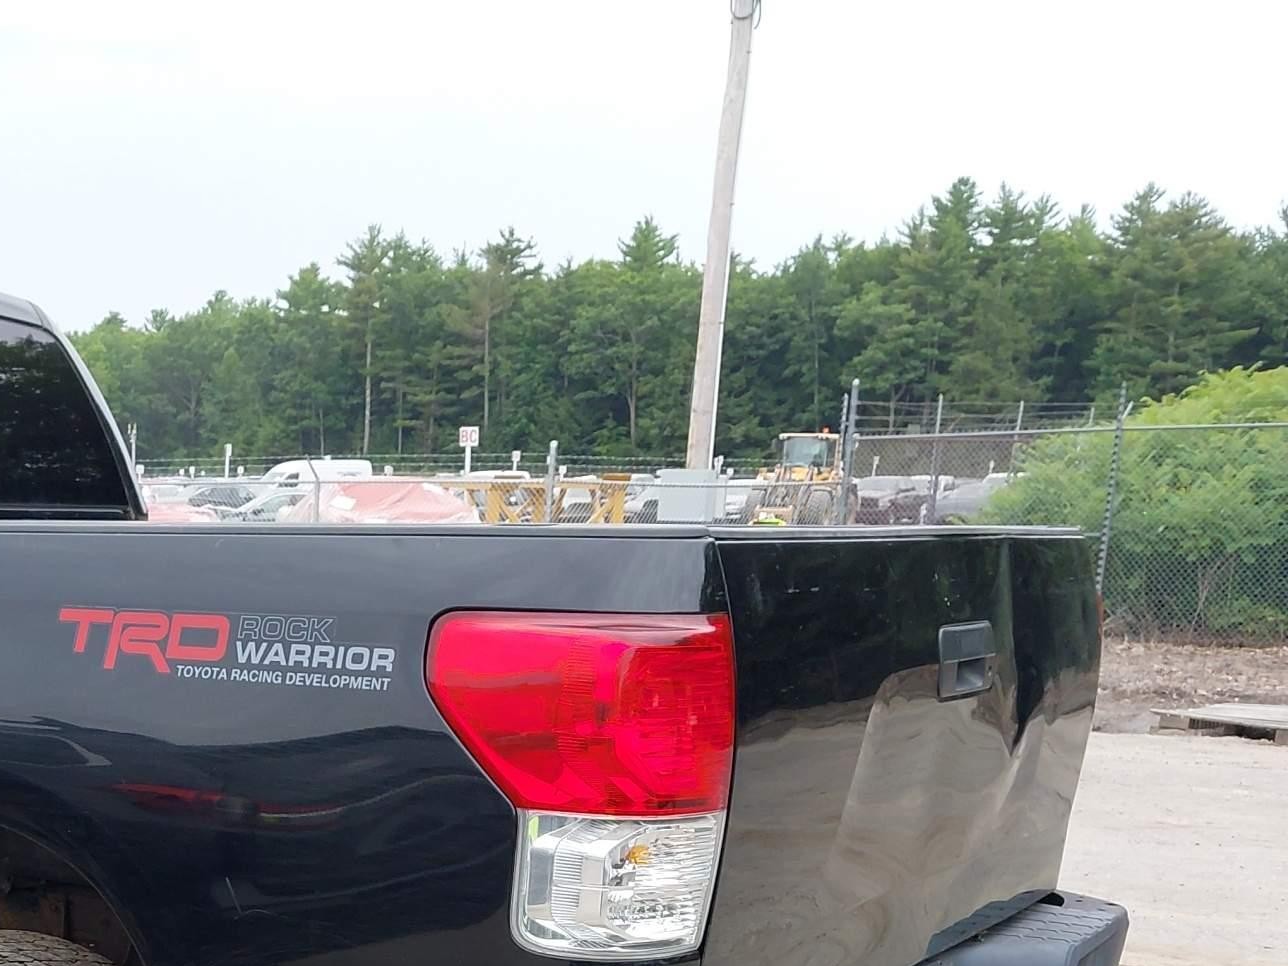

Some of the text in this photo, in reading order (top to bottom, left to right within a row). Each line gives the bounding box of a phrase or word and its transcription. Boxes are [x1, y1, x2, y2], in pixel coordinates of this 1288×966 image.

[59, 606, 231, 674] TRD
[237, 615, 334, 643] ROCK
[235, 641, 397, 672] WARRIOR
[176, 664, 392, 692] TOYOTA RACING DEVELOPMENT
